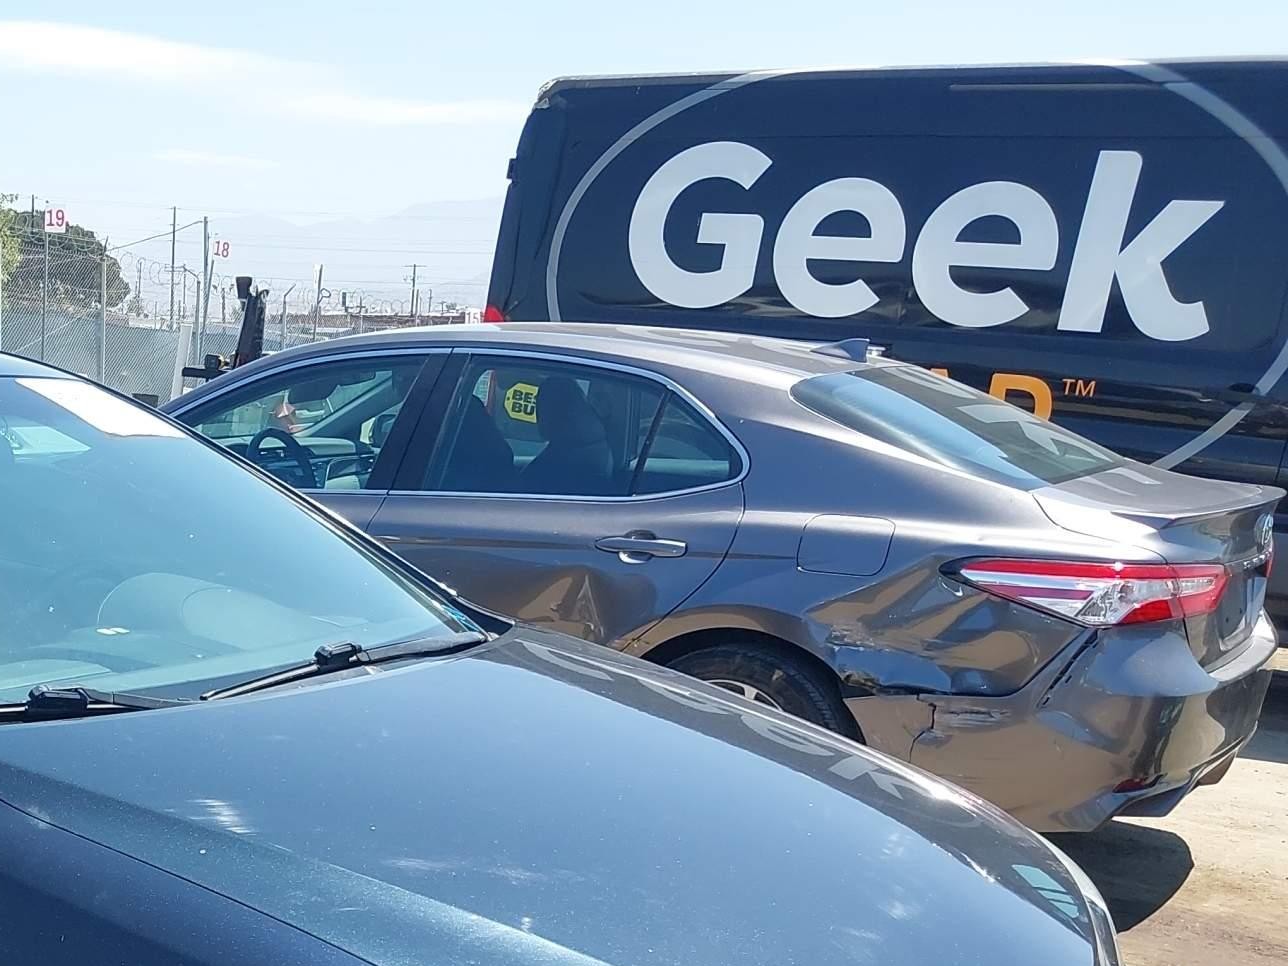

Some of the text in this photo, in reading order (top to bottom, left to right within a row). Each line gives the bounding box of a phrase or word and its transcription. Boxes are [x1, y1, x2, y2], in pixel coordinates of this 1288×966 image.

[46, 208, 65, 228] 19
[213, 240, 230, 258] 18
[628, 141, 1225, 342] Geek
